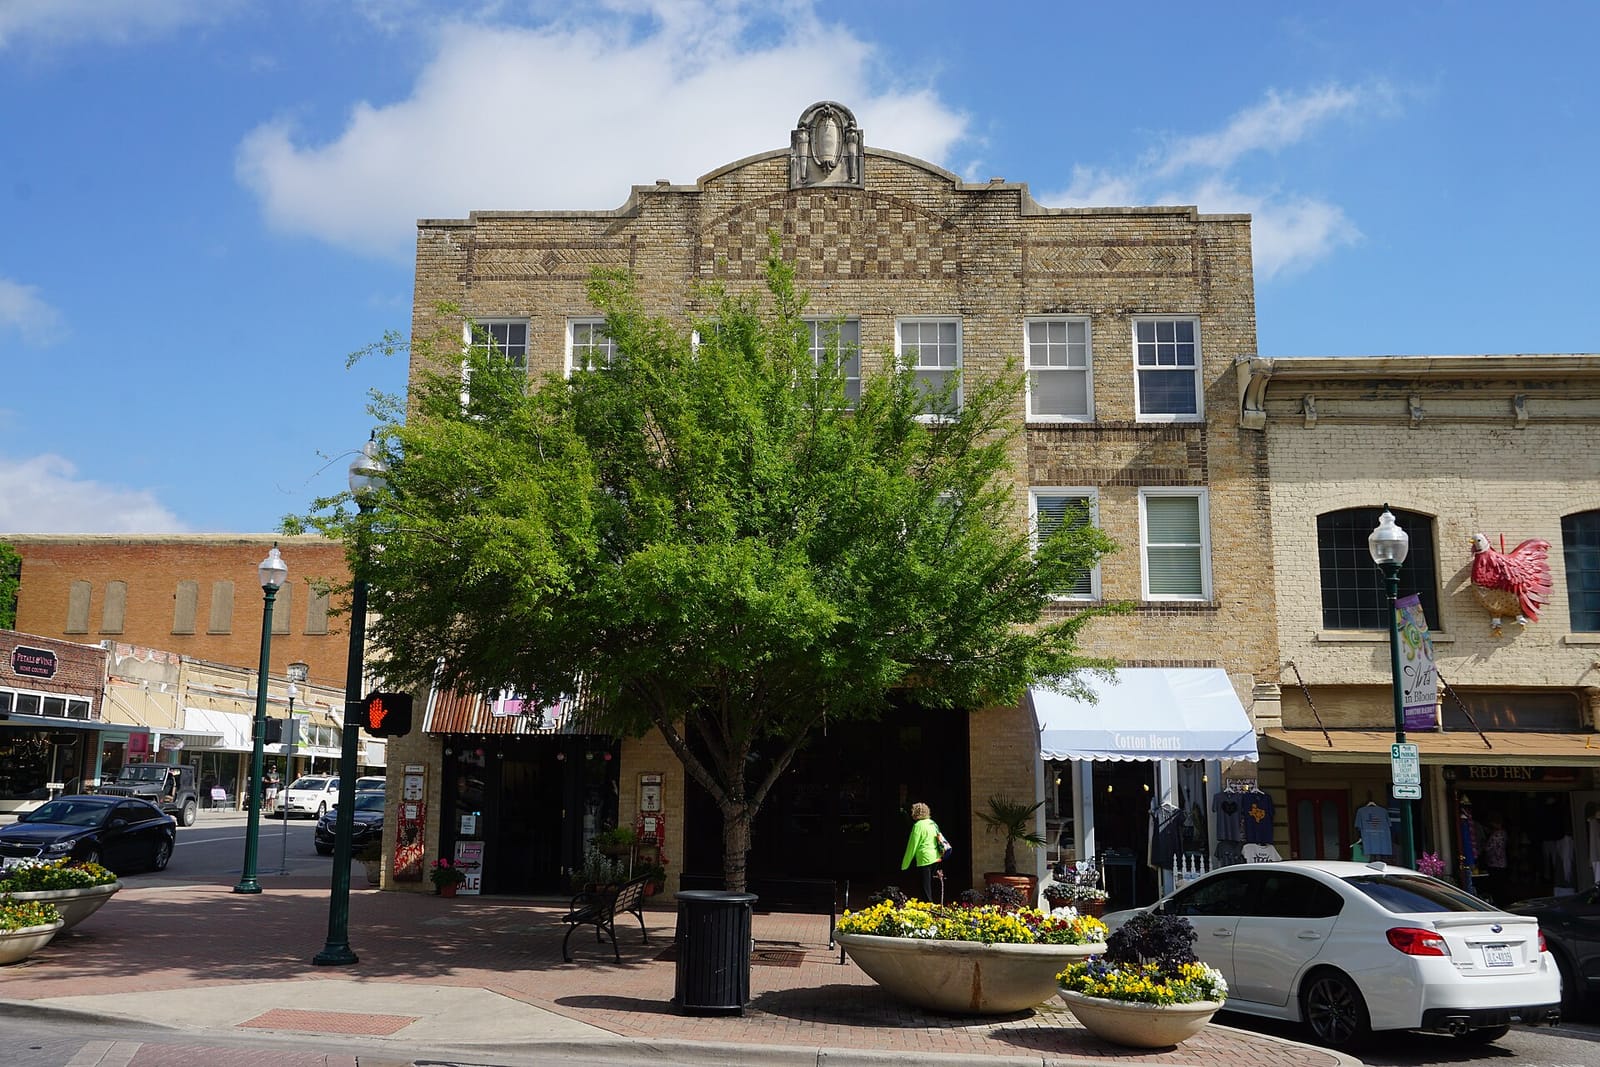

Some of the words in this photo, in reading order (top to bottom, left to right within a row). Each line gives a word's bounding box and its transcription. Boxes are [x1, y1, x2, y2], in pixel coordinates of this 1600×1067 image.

[1404, 662, 1432, 695] Arts
[1405, 695, 1413, 704] in
[1414, 691, 1435, 702] Bloom
[1115, 733, 1146, 749] Cotton
[1149, 733, 1181, 749] Hearts
[1393, 746, 1399, 758] 3
[1470, 766, 1498, 778] RED
